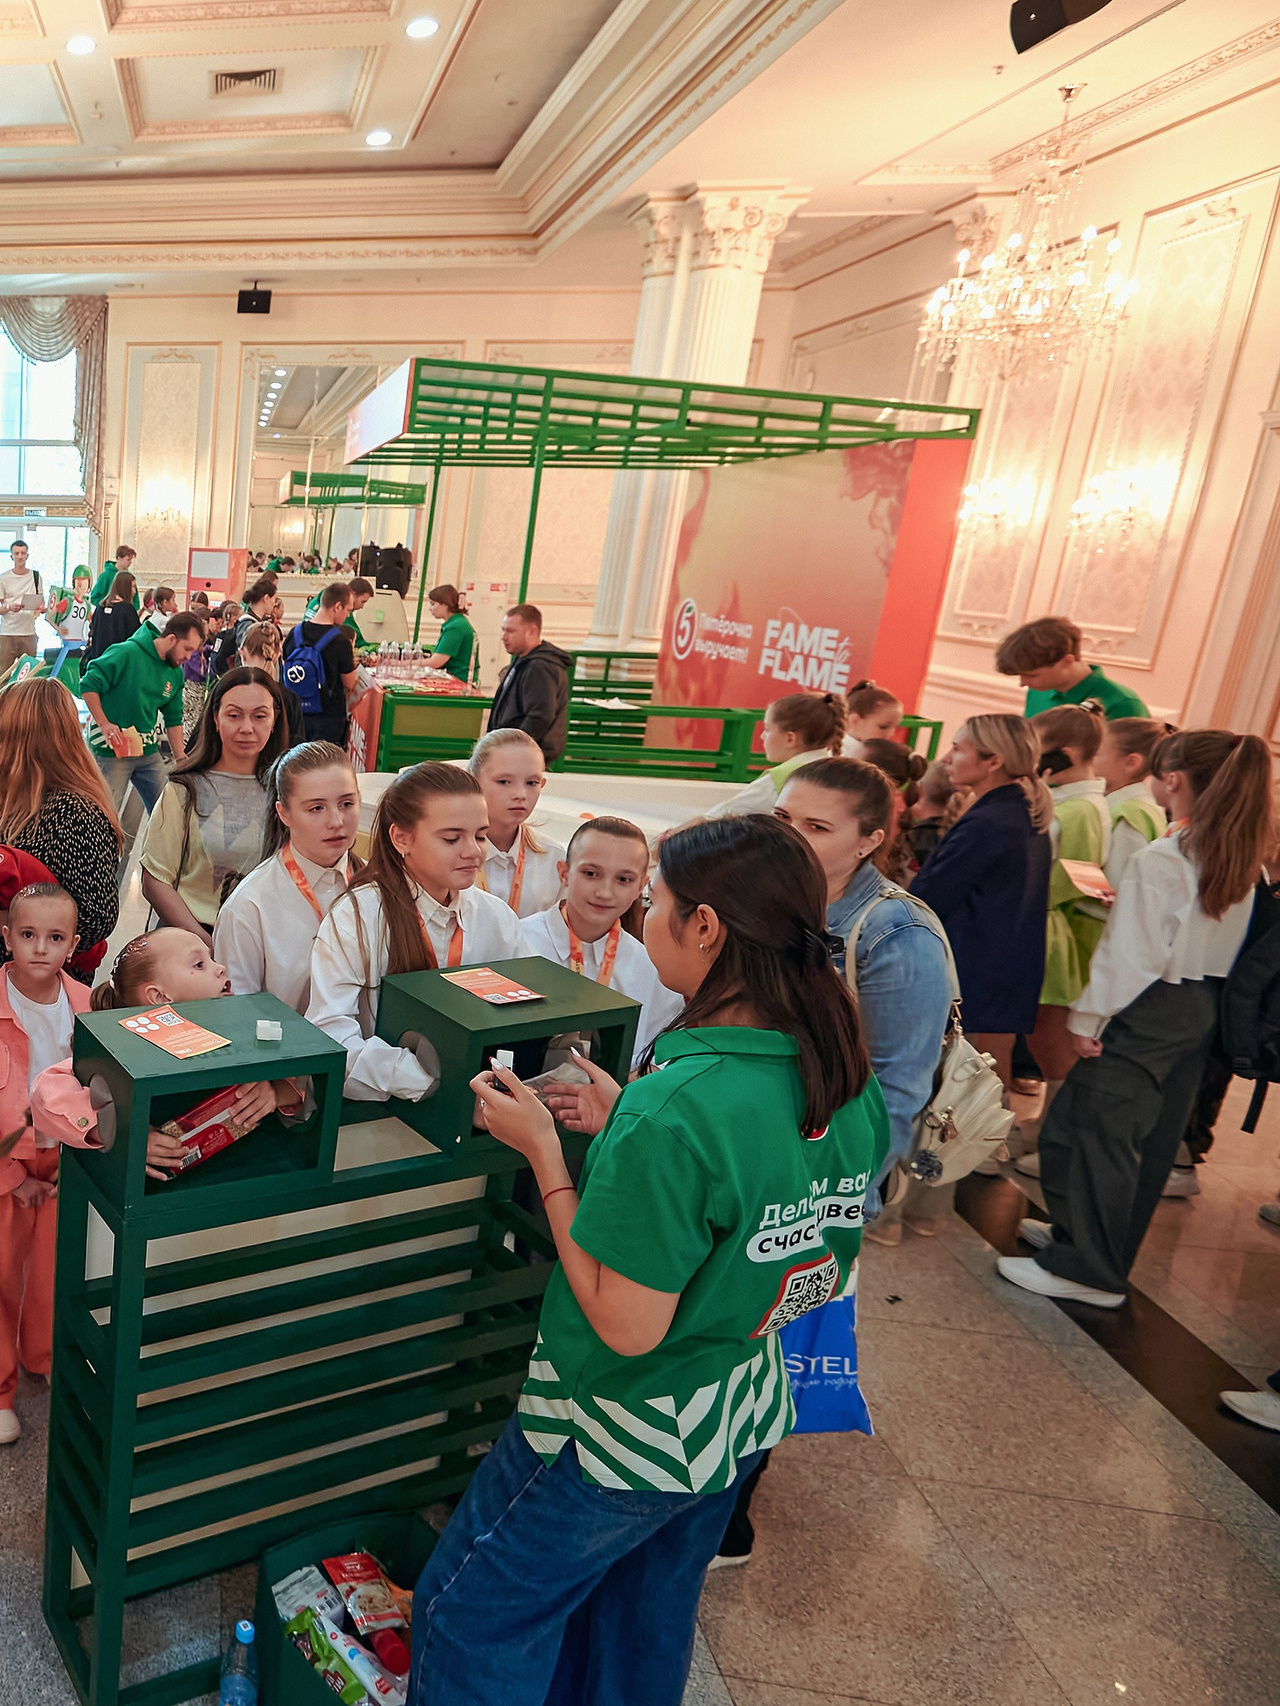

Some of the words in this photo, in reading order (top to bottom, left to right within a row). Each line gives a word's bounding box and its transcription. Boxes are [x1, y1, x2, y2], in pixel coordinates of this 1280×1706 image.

[71, 605, 87, 620] 30
[700, 613, 753, 638] Пятёрочка
[695, 638, 749, 664] выручает!
[763, 619, 839, 660] FAME
[835, 636, 855, 664] to
[758, 648, 850, 695] FLAME
[784, 1353, 858, 1375] STEL
